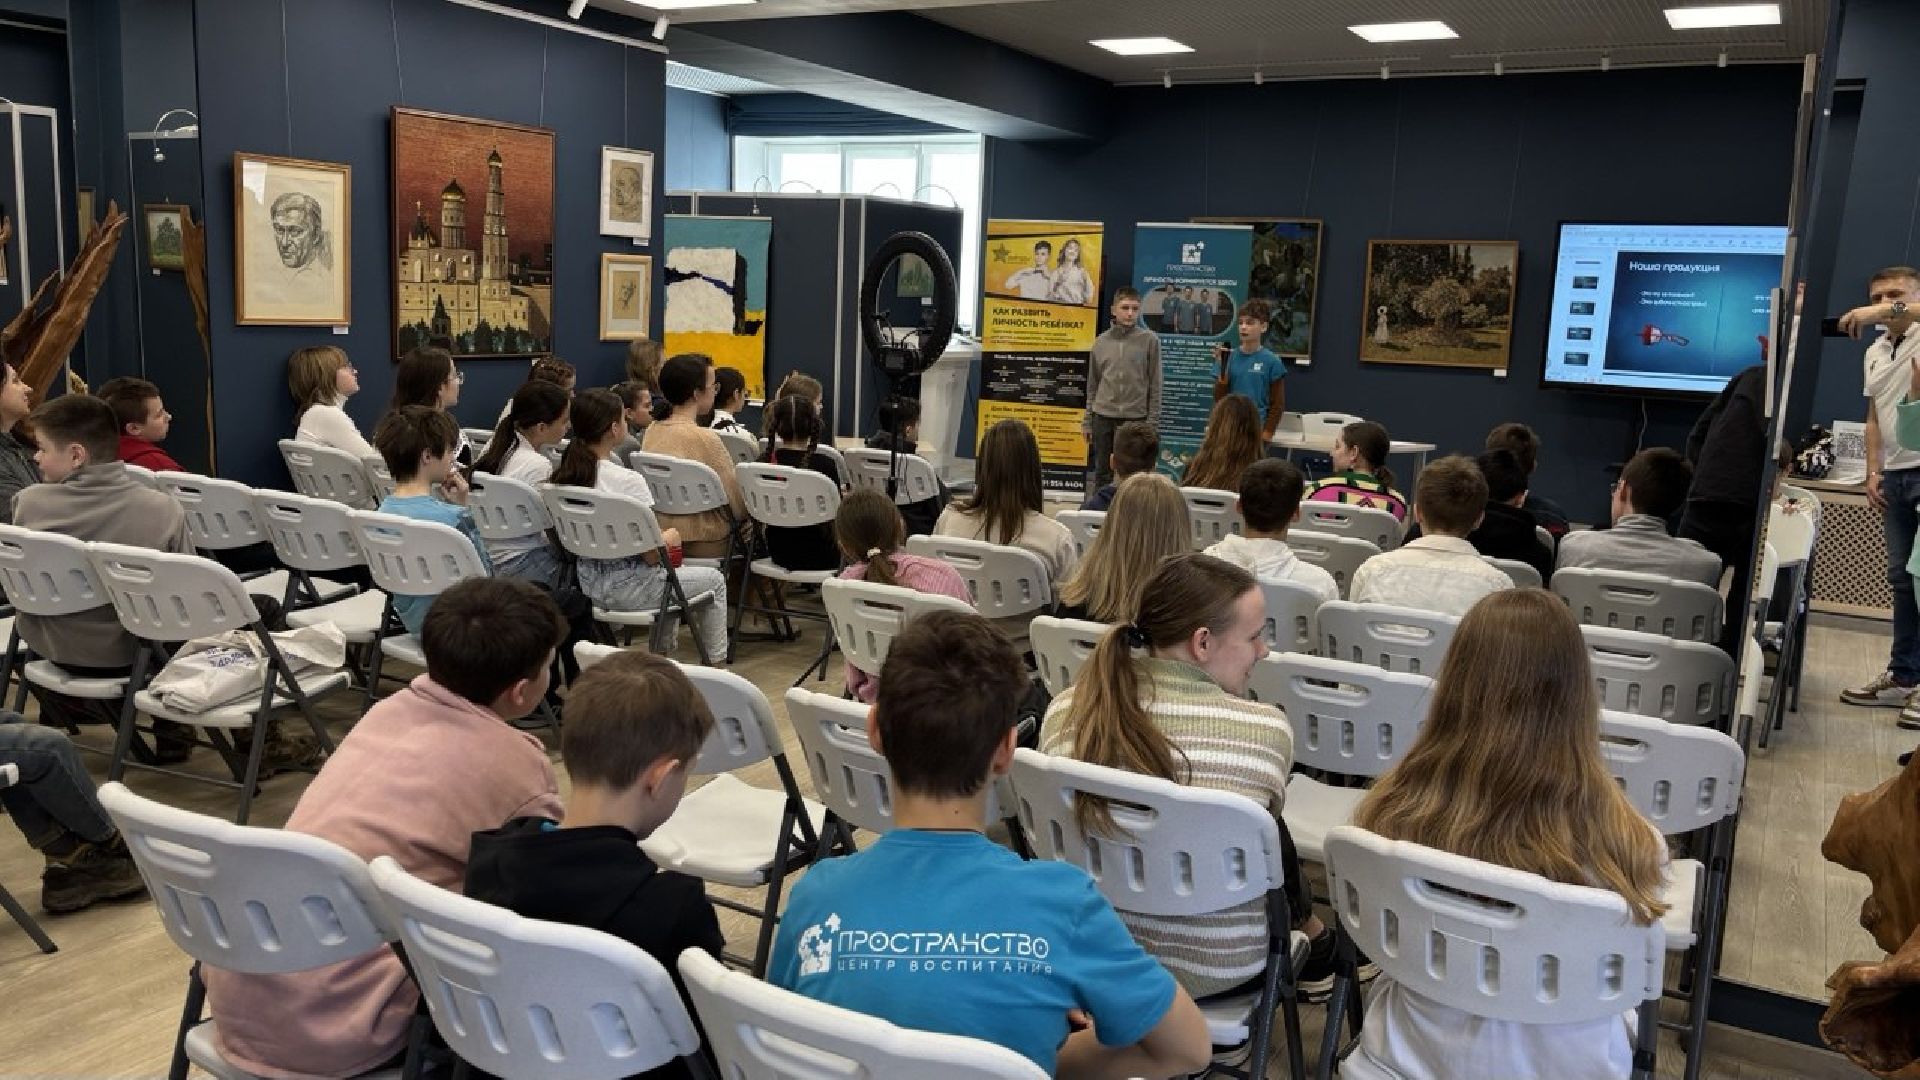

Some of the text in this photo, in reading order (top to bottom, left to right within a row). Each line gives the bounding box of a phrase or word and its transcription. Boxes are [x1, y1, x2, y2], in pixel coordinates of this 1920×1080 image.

[1629, 261, 1720, 274] Наша продукция
[992, 308, 1051, 317] КАК РАЗВИТЬ
[992, 318, 1039, 328] ЛИЧНОСТЬ
[838, 930, 1049, 959] ПРОСТРАНСТВО
[837, 959, 1052, 974] ЦЕНТР ВОСПИТАНИЯ
